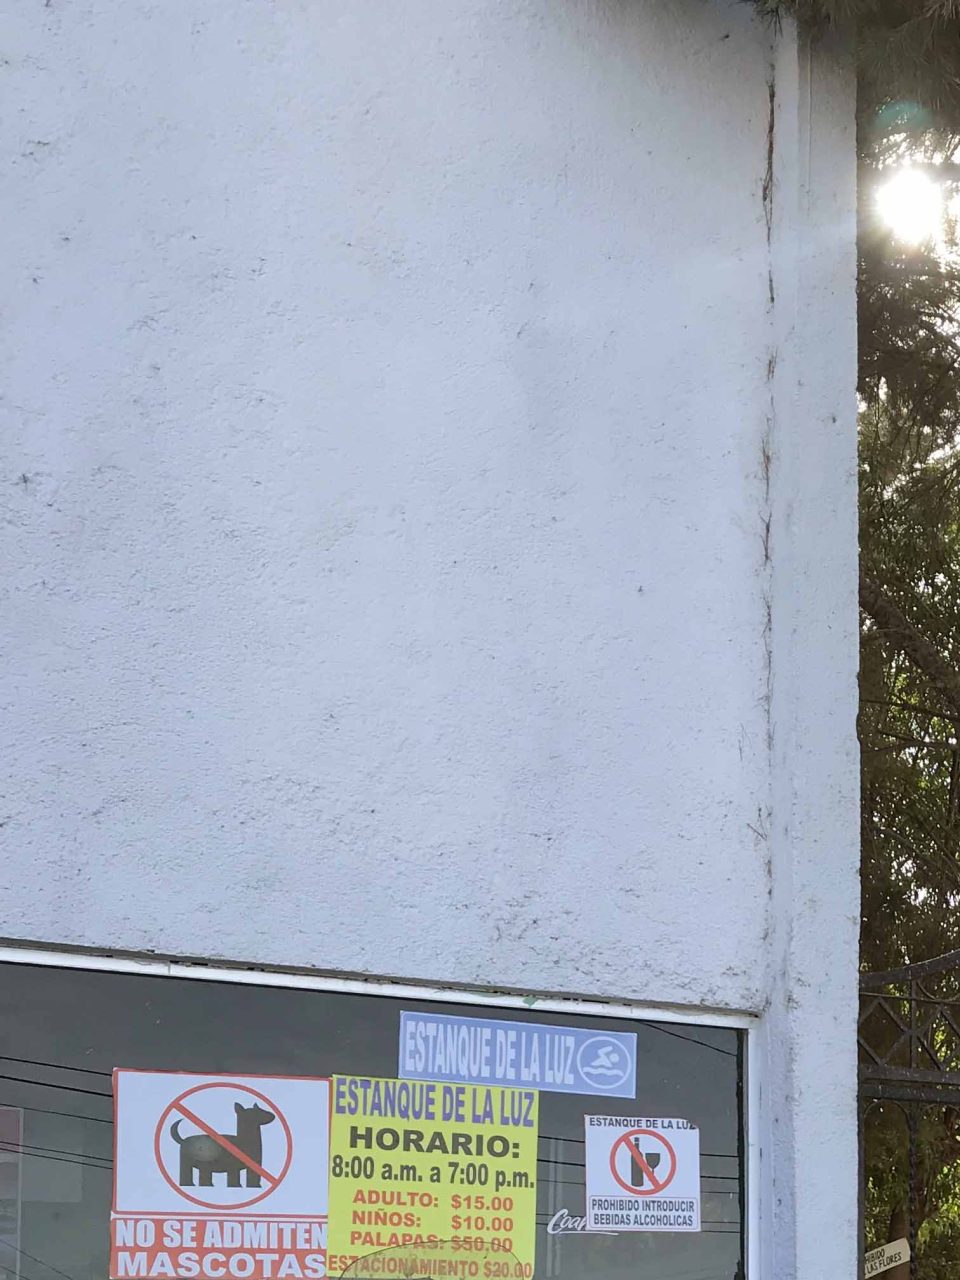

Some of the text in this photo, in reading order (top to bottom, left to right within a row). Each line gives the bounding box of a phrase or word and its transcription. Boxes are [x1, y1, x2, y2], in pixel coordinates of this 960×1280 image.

[405, 1020, 575, 1085] ESTANQUE DE LA LUZ
[335, 1078, 534, 1127] ESTANQUE DE LA LUZ
[589, 1117, 643, 1129] ESTANQUE
[645, 1119, 658, 1129] DE
[661, 1120, 674, 1129] LA
[350, 1126, 520, 1159] HORARIO:
[332, 1154, 535, 1192] 8:00 a.m. a 7:00 p.m.
[353, 1189, 514, 1212] ADULTO: $15.00
[592, 1198, 695, 1213] PROHIBIDO INTRODUCIR
[352, 1208, 514, 1233] NIÑOS: $10.00
[594, 1213, 693, 1227] BEBIDAS ALCOHOLICAS
[115, 1219, 328, 1250] NO SE ADMITEN
[350, 1231, 513, 1254] PALAPAS: $50.00
[117, 1251, 326, 1279] MASCOTAS
[328, 1254, 532, 1279] ESTACIONAMIENTO $20.00
[879, 1252, 902, 1268] FLORES
